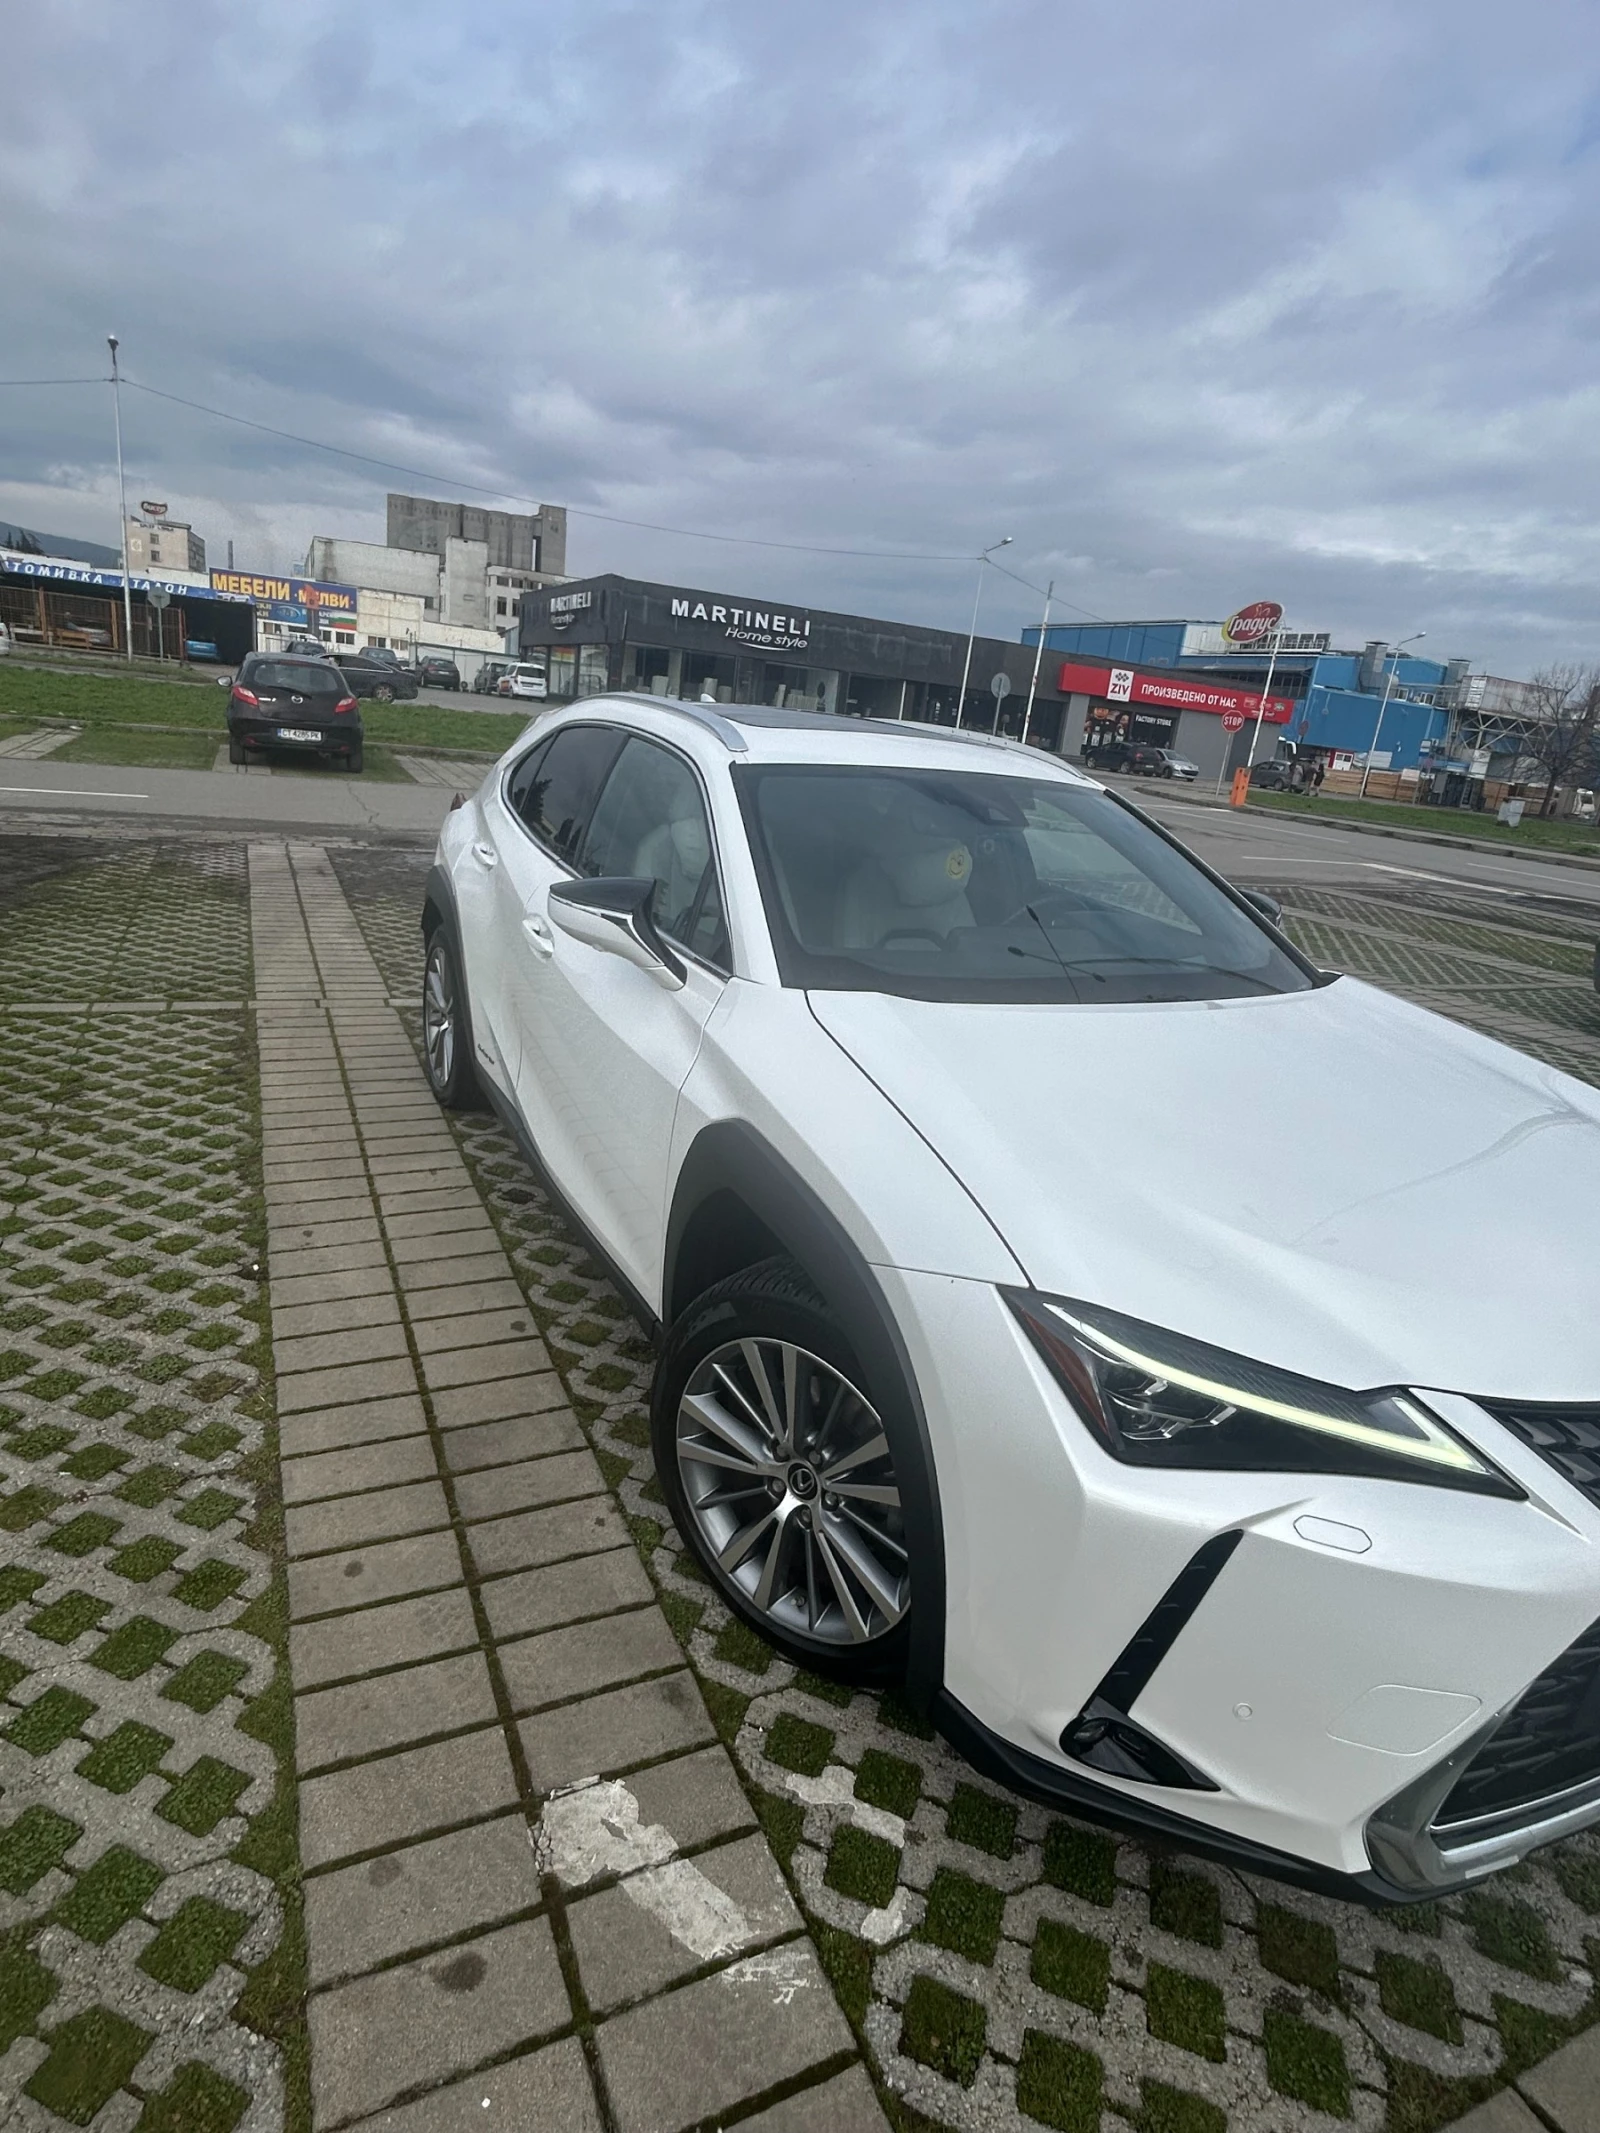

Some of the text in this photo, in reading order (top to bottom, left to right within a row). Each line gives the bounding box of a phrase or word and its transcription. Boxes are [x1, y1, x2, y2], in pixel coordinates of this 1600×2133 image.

[212, 573, 350, 609] МЕБЕЛИ МЛВИ
[671, 599, 810, 636] MARTINELI
[1228, 616, 1277, 637] Градус
[725, 627, 808, 648] Home style
[1110, 683, 1130, 695] ZIV
[1141, 684, 1206, 705] ПРОИЗВЕДЕНО
[1207, 695, 1219, 705] ОТ
[1219, 697, 1237, 708] НАС
[1135, 714, 1172, 727] FACTORY STORE
[1223, 716, 1243, 727] STOP
